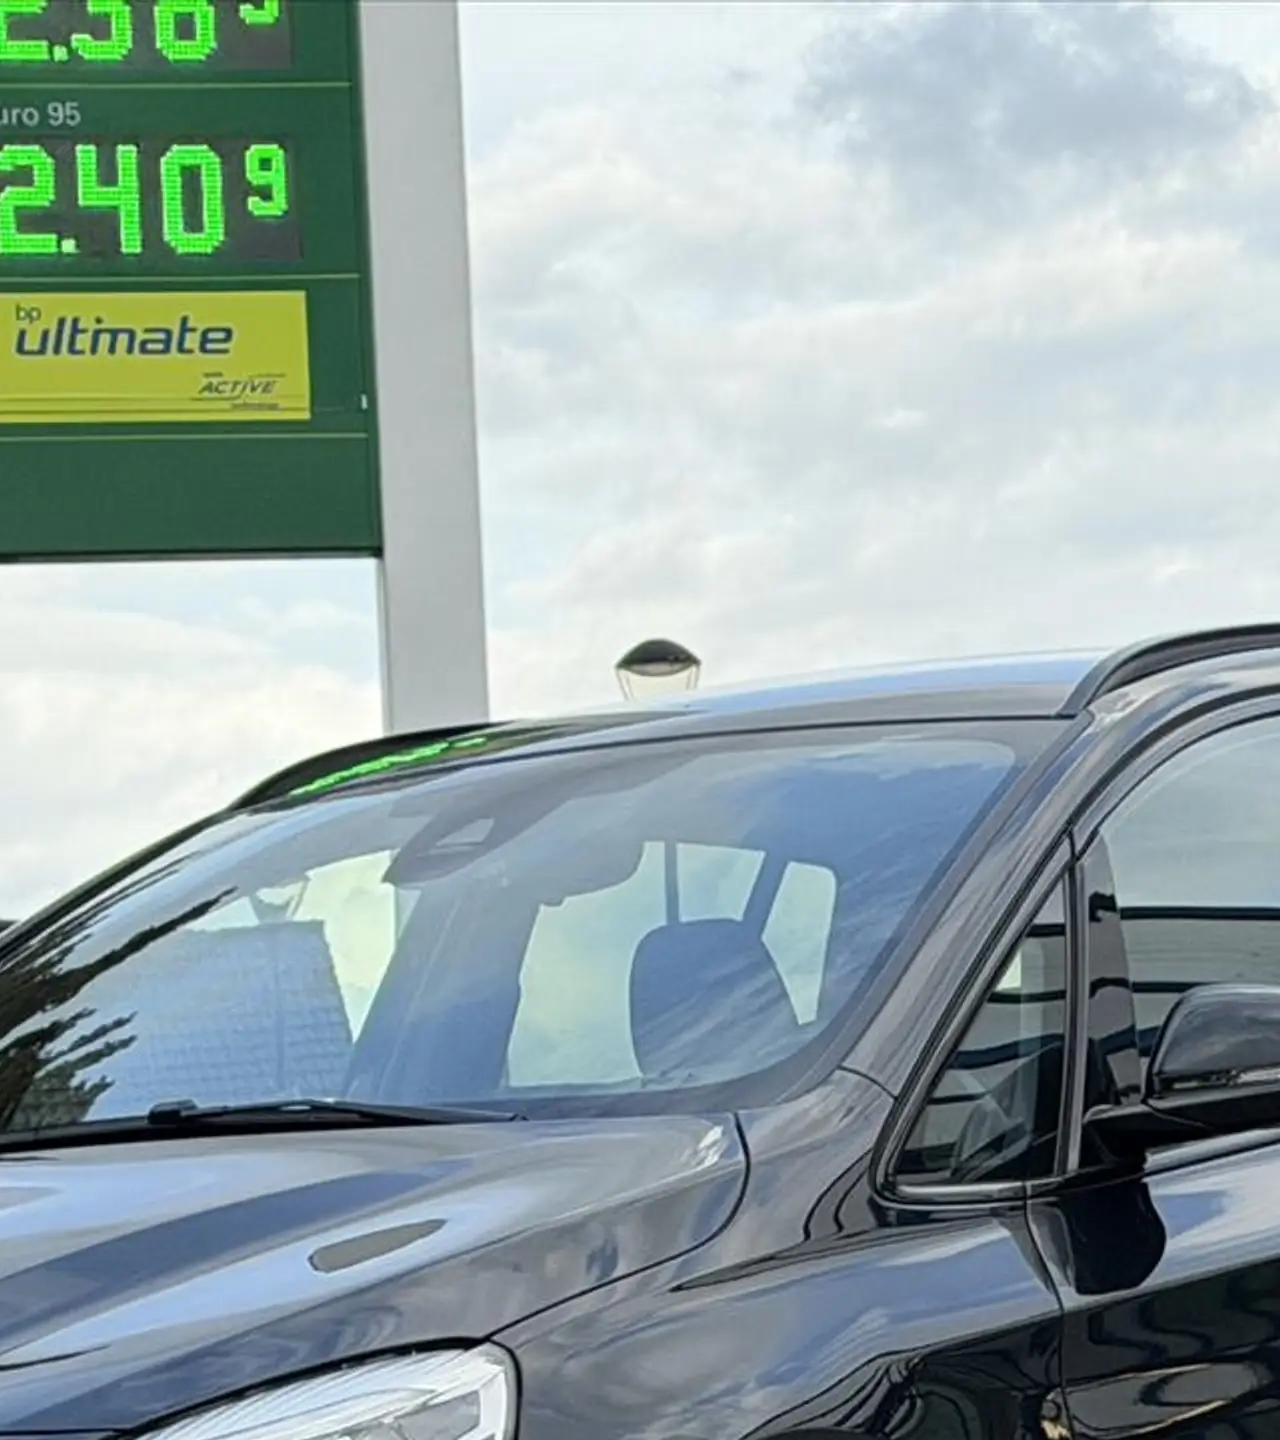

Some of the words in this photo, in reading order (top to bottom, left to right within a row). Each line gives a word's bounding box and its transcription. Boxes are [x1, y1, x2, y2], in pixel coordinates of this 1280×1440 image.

[46, 101, 82, 127] 95
[15, 304, 42, 325] bp
[15, 315, 234, 356] ultimate
[197, 379, 279, 396] ACTIVE
